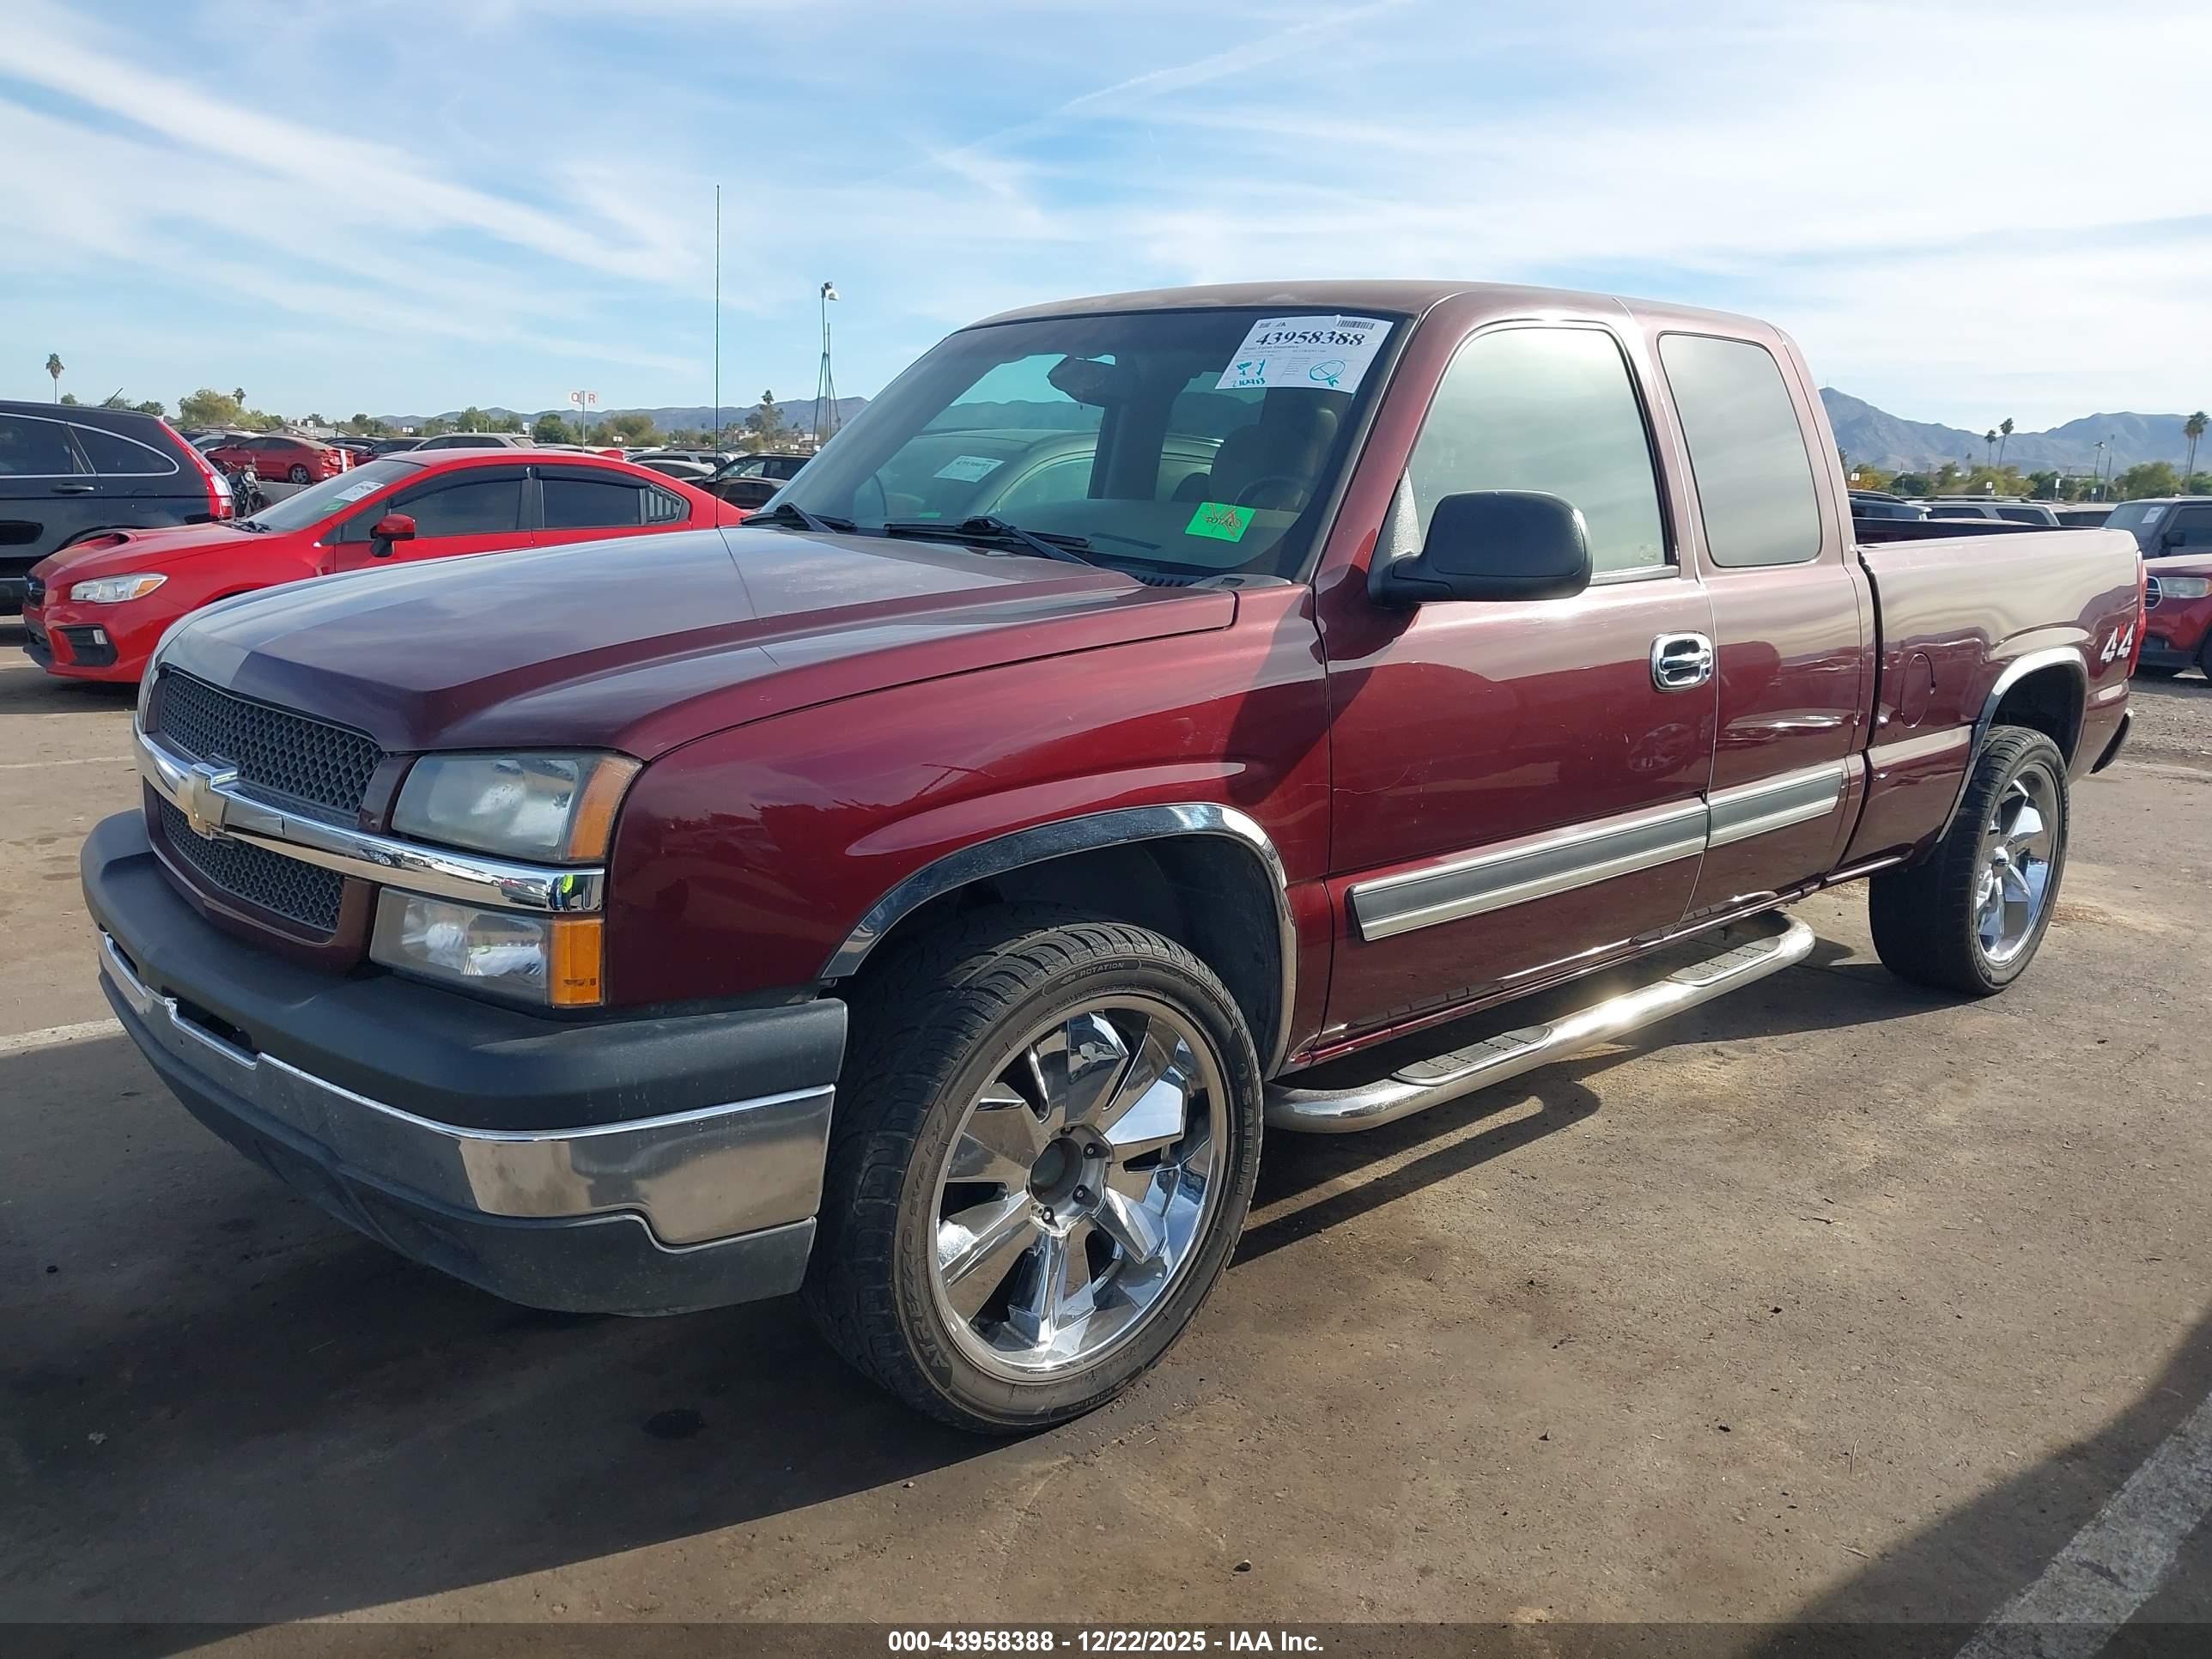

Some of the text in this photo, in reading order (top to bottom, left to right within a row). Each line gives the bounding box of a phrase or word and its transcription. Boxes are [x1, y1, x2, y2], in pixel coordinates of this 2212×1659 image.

[1255, 330, 1366, 346] 43958388
[588, 393, 596, 404] R
[1079, 962, 1126, 976] ROTATION
